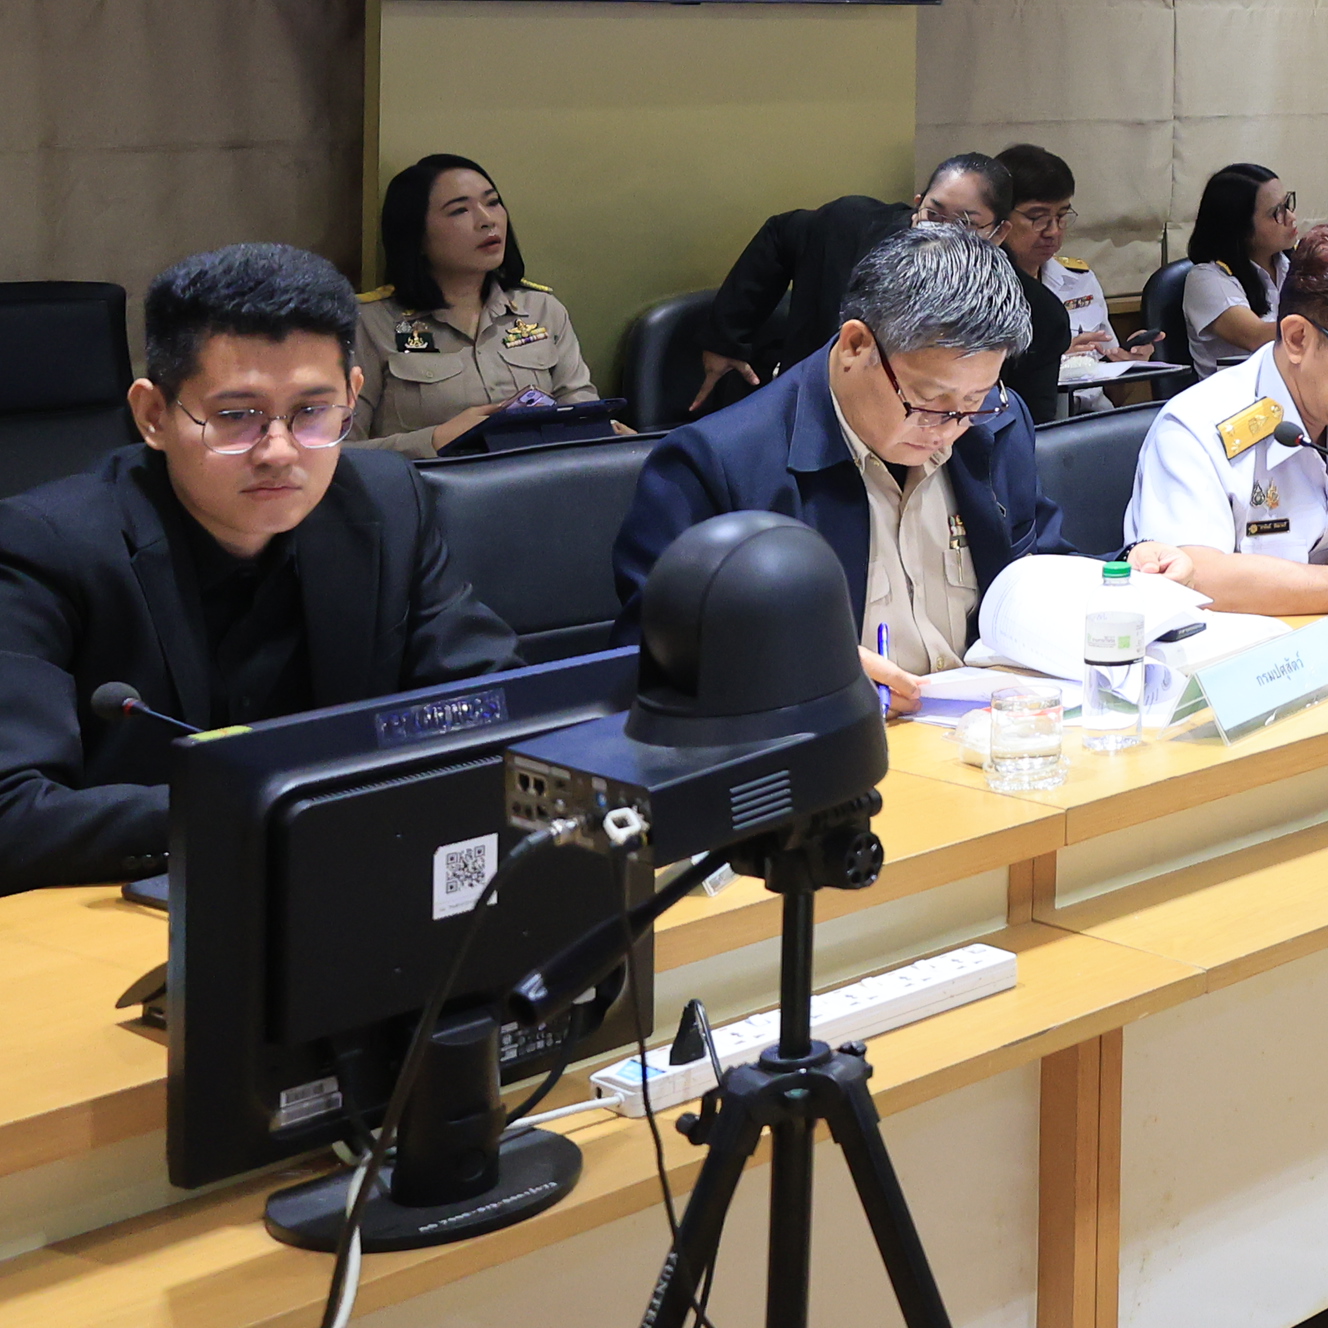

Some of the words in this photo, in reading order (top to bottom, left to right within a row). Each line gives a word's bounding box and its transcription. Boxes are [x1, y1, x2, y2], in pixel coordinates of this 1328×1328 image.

[1256, 651, 1305, 687] กรมปศุสัตว์
